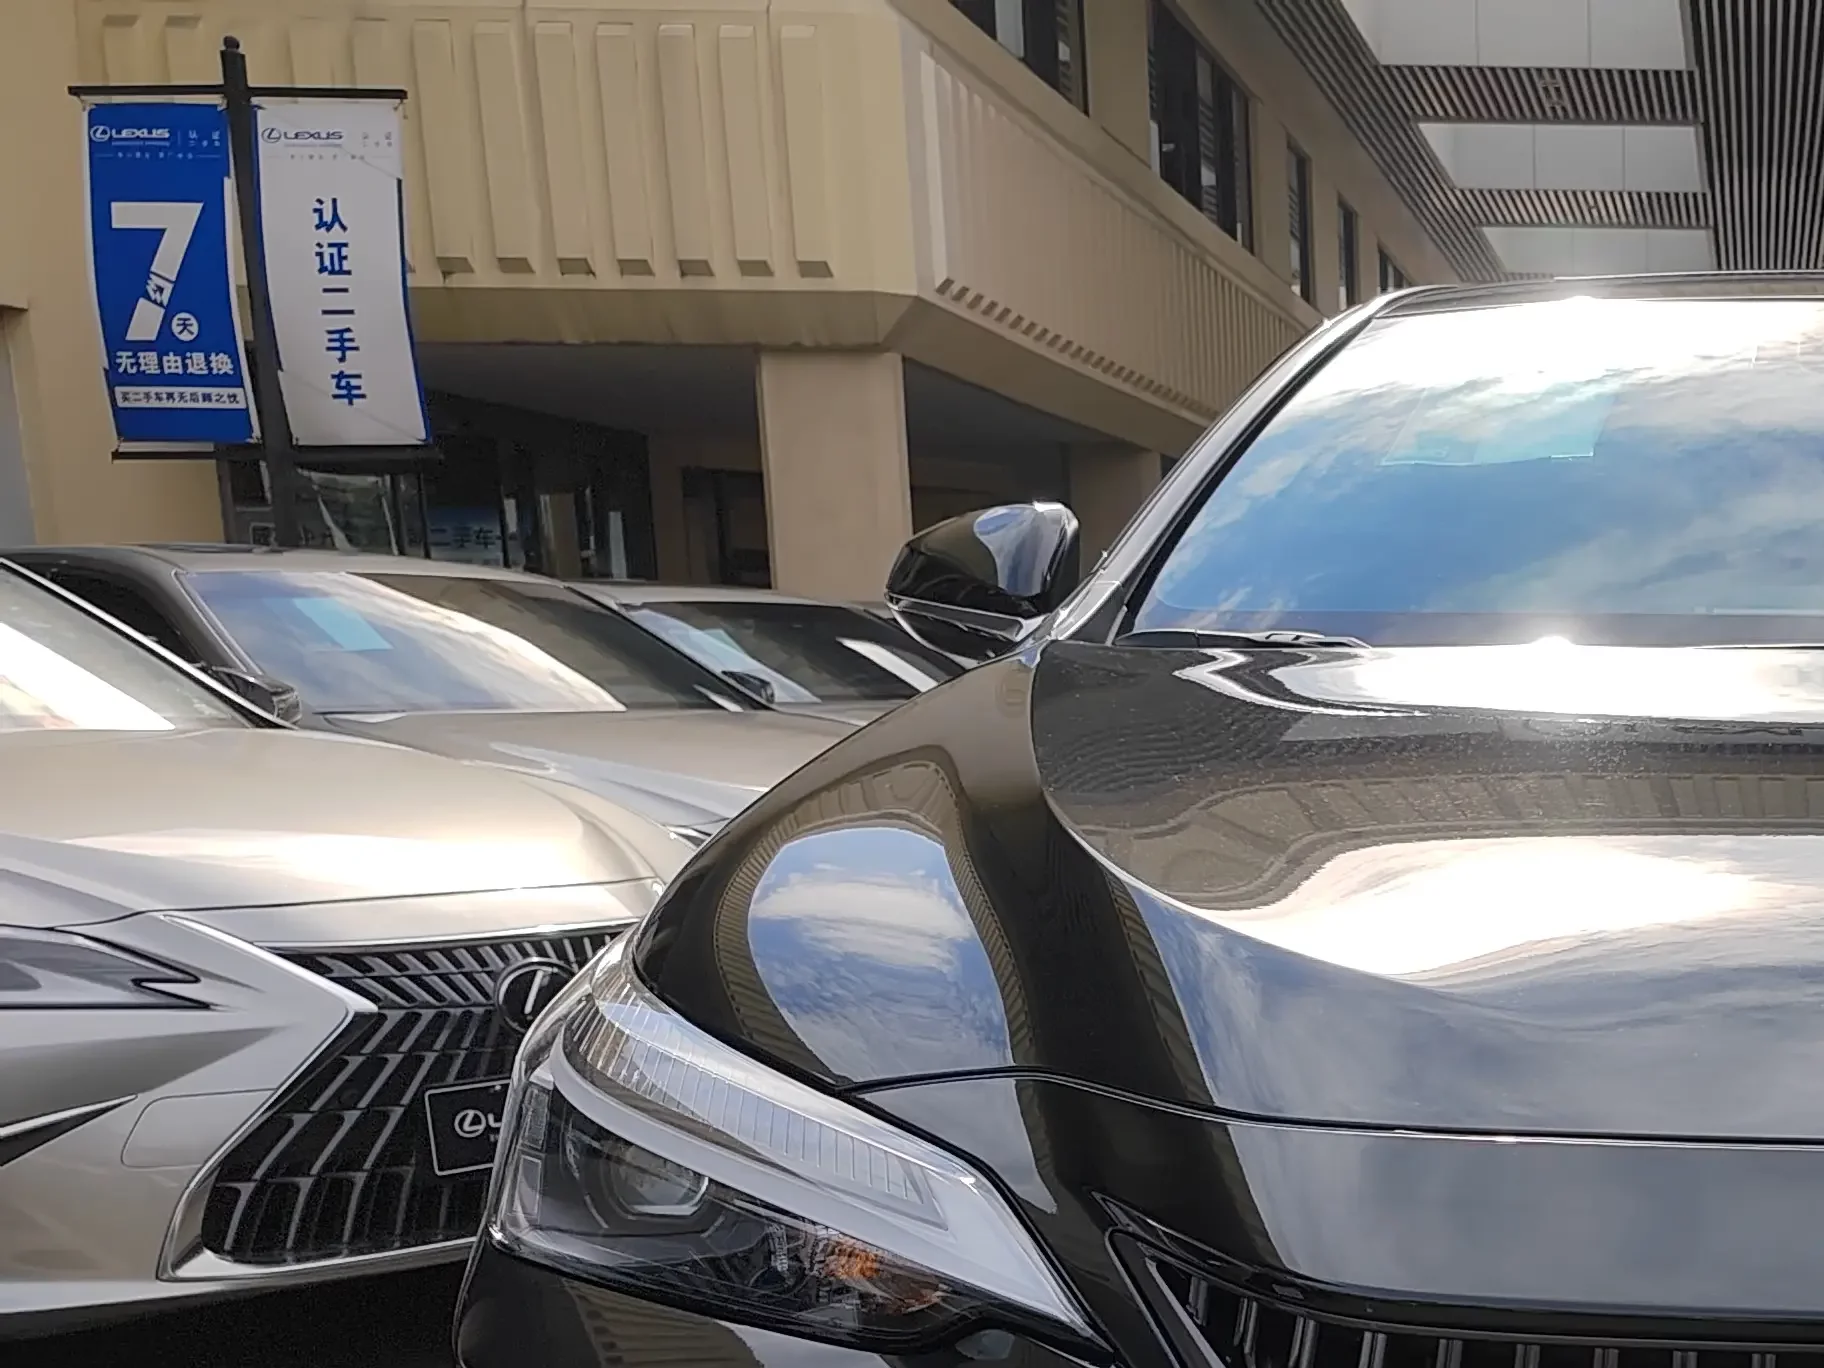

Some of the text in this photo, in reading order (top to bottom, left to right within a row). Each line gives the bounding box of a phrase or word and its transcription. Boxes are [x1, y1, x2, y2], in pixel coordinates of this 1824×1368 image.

[111, 128, 170, 138] LEXUS
[283, 131, 344, 140] LEXUS
[312, 197, 367, 406] 认证二手车
[115, 351, 234, 375] 无理由退换
